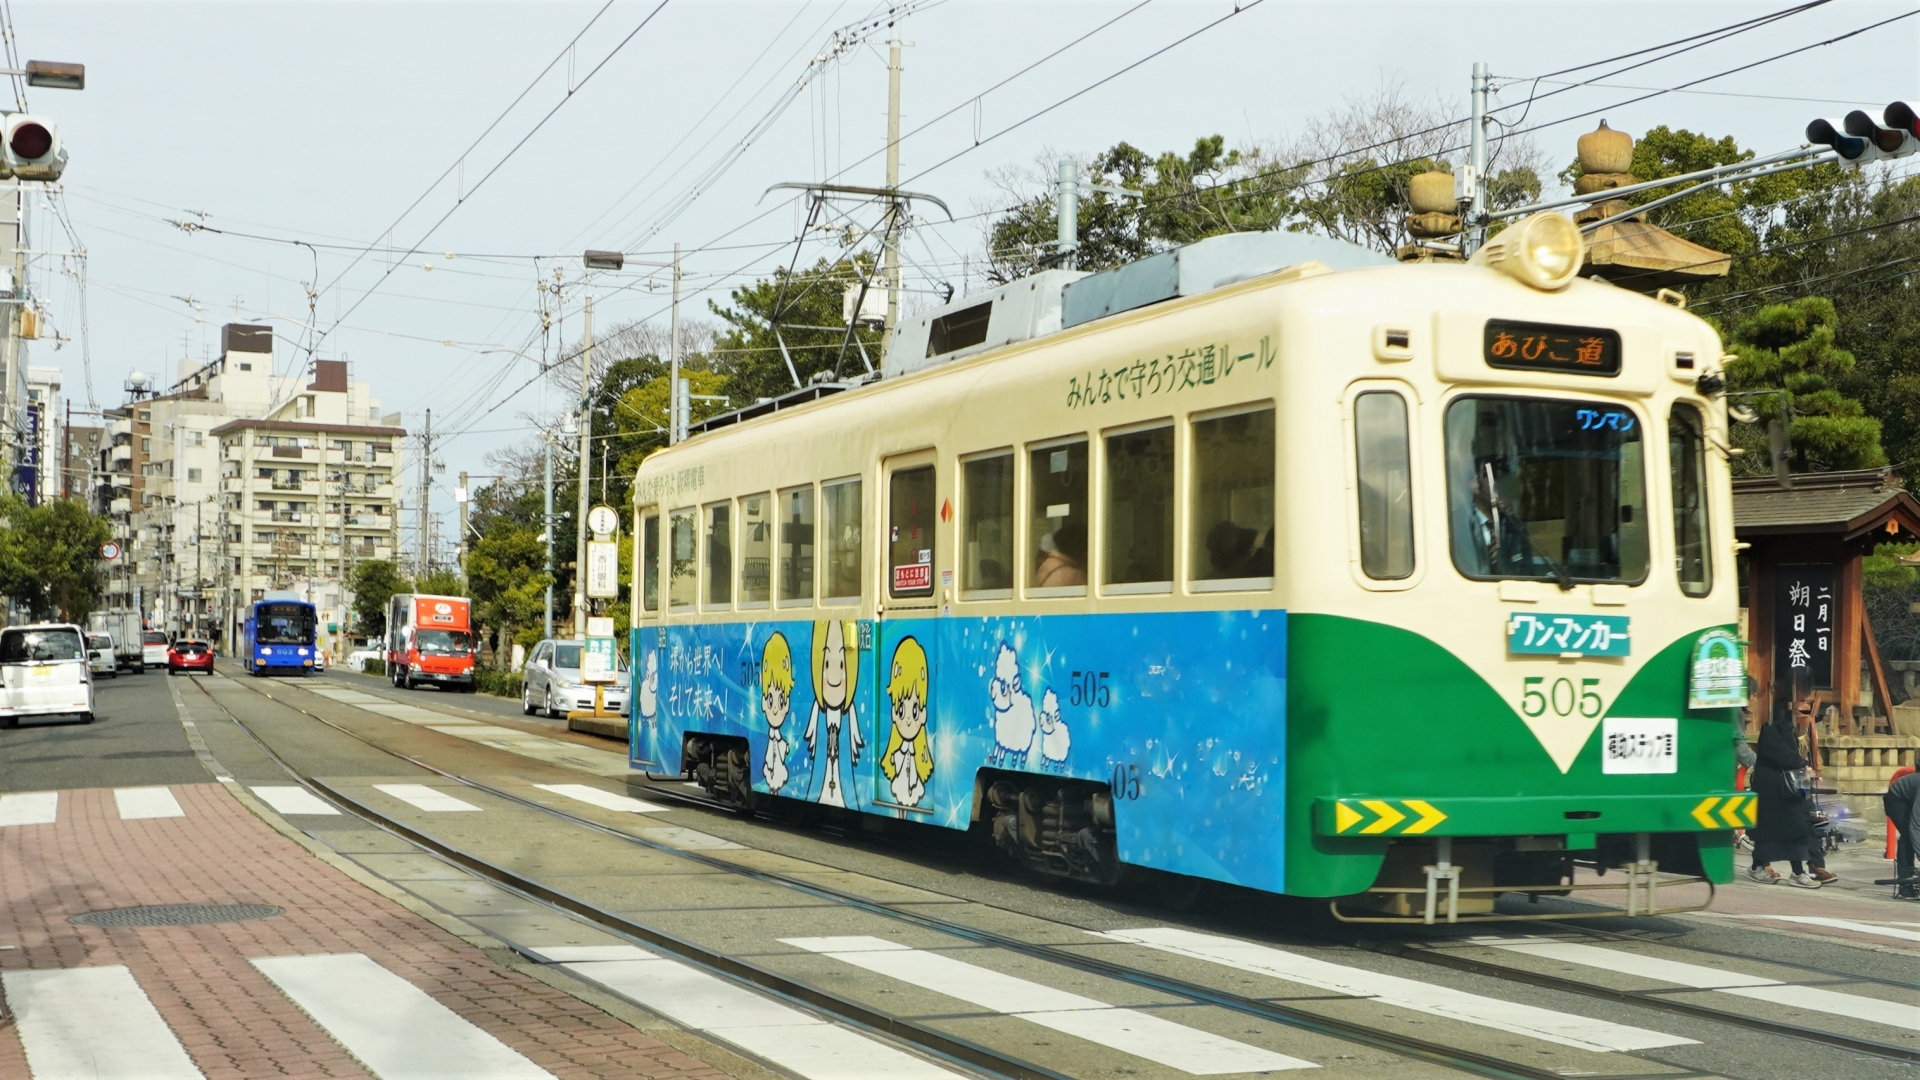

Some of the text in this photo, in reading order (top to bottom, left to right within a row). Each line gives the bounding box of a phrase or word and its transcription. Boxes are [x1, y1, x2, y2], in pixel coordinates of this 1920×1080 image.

[1490, 331, 1604, 365] あびこ道
[1066, 334, 1278, 410] みんなで守ろう交通ルール
[1576, 409, 1635, 432] ワンマン
[105, 545, 115, 556] 40
[1512, 615, 1628, 651] ワンマンカー
[1789, 580, 1811, 668] 朔日祭
[1816, 586, 1832, 651] 二月一日
[740, 661, 761, 687] 505
[1070, 670, 1110, 708] 505
[1522, 676, 1603, 719] 505
